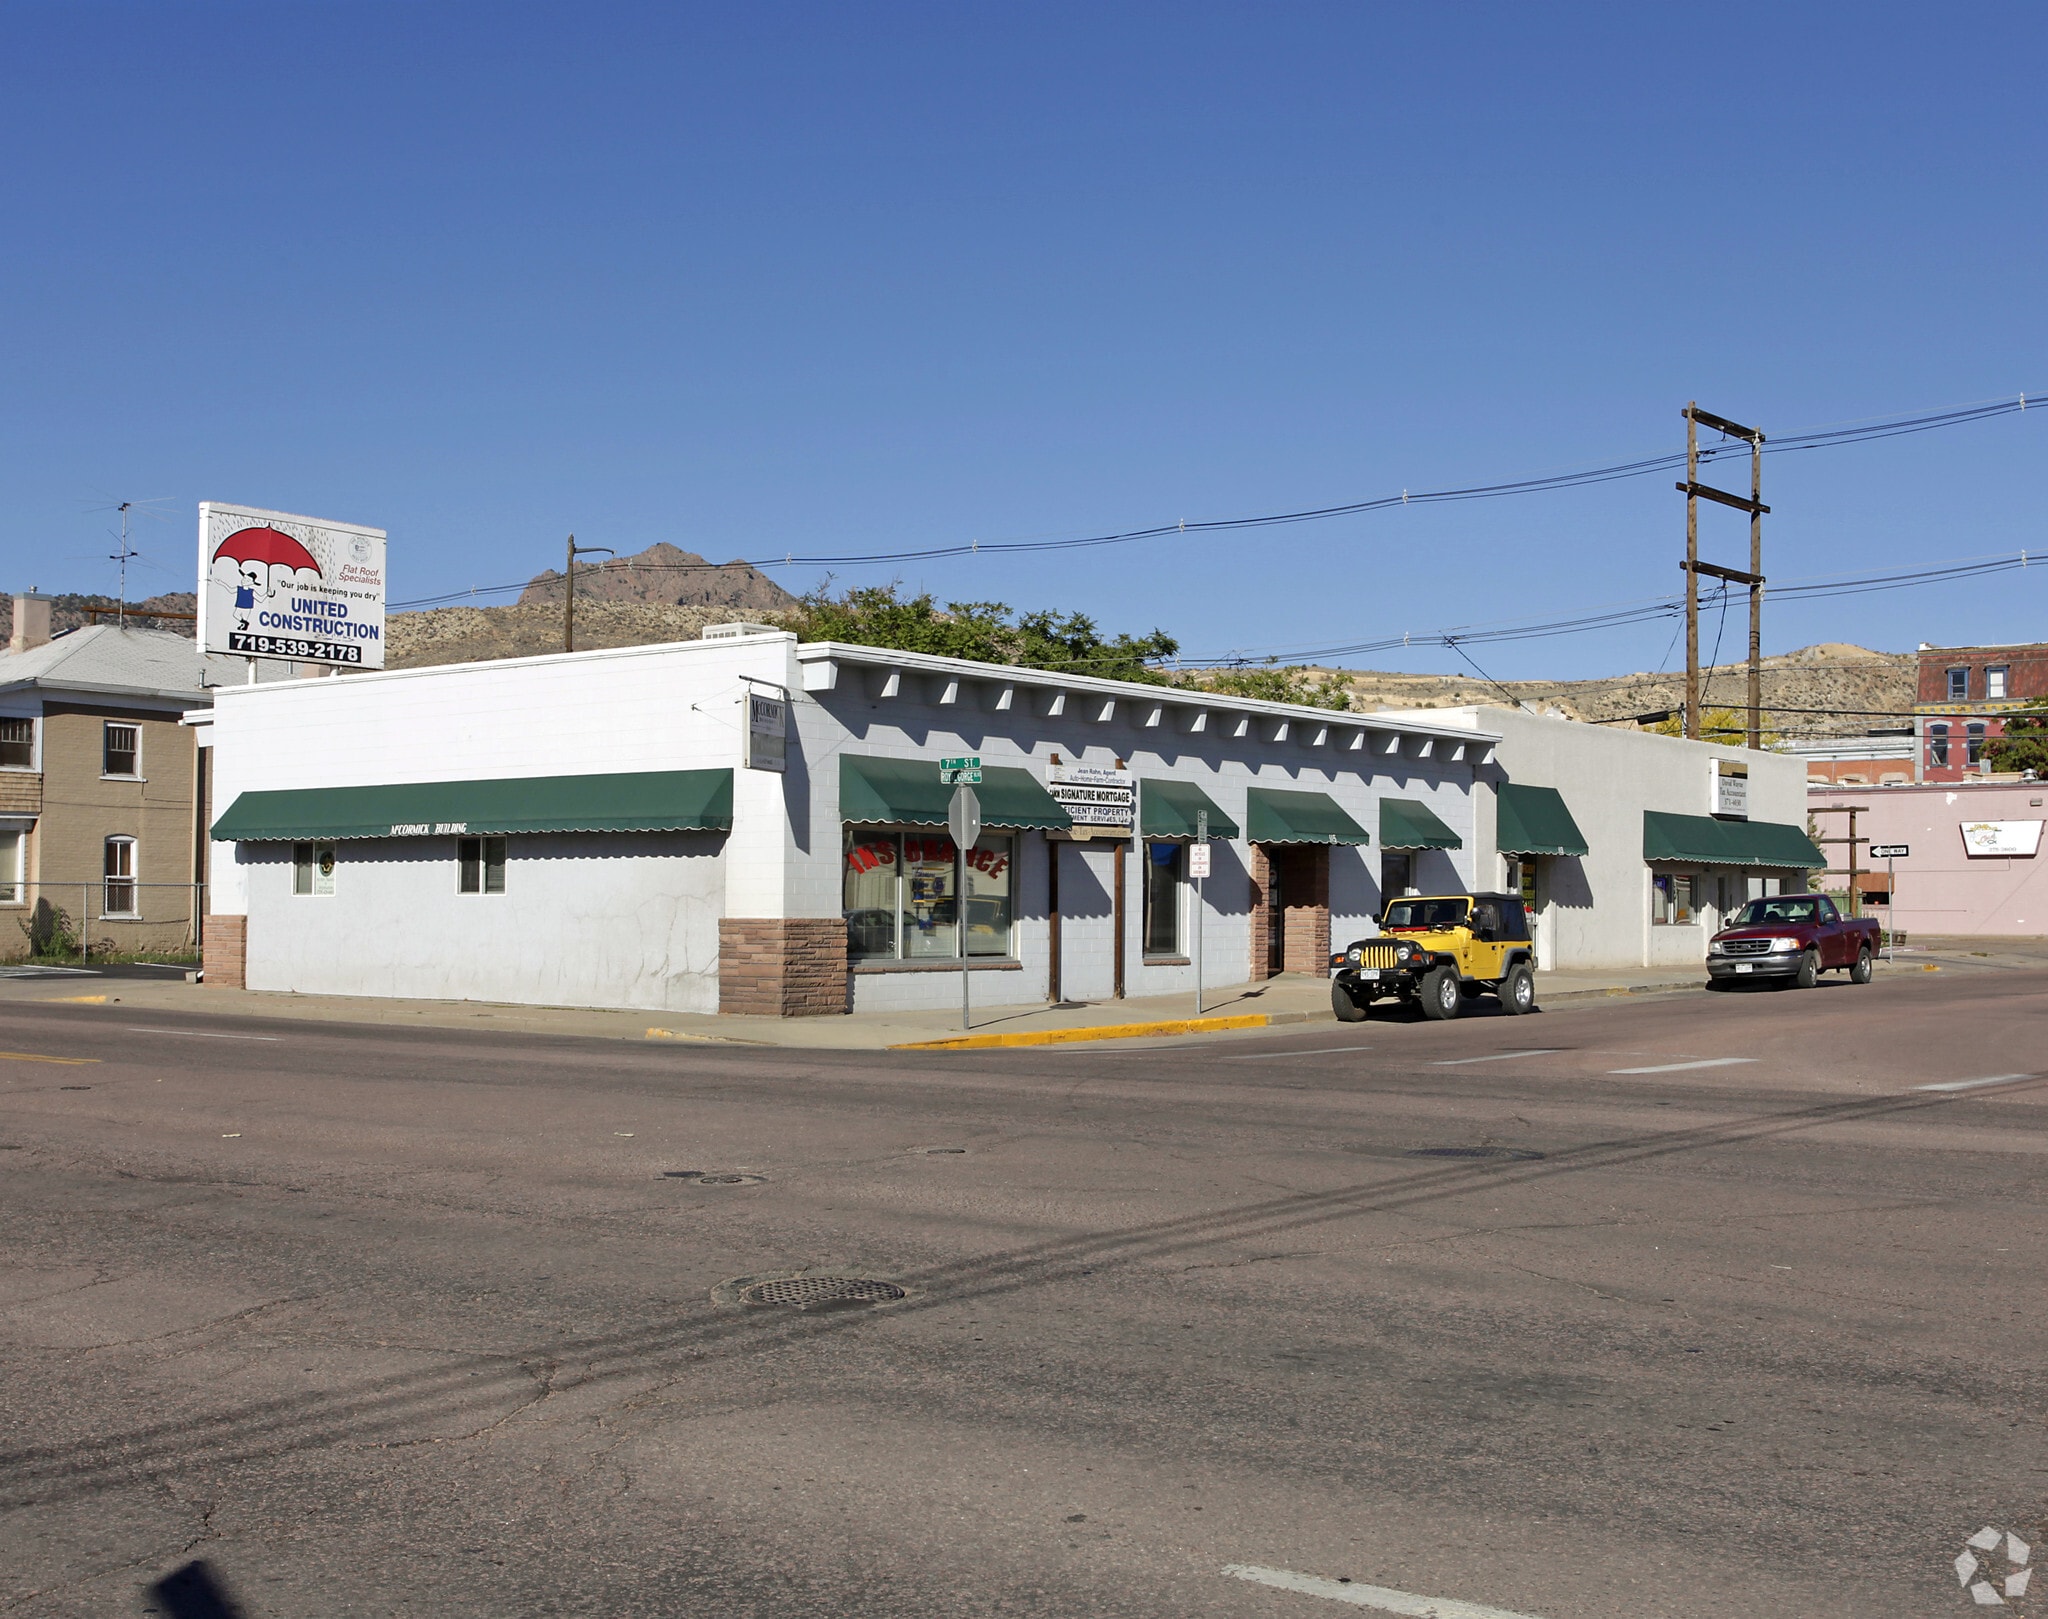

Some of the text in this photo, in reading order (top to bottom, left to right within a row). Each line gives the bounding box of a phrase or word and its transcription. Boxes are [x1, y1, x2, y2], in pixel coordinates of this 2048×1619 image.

[343, 564, 379, 577] Flat Roof
[338, 572, 382, 586] Specialists
[296, 582, 309, 592] job
[310, 584, 318, 592] is
[319, 585, 349, 599] keeping
[350, 590, 363, 600] you
[291, 597, 348, 618] UNITED
[259, 611, 380, 640] CONSTRUCTION
[234, 635, 359, 662] 719-539-2178
[1061, 789, 1096, 801] SIGNATURE
[1096, 790, 1130, 803] MORTGAGE
[1093, 807, 1129, 816] PROPERTY
[434, 822, 468, 834] BUILDING
[847, 840, 1009, 880] INSURANCE
